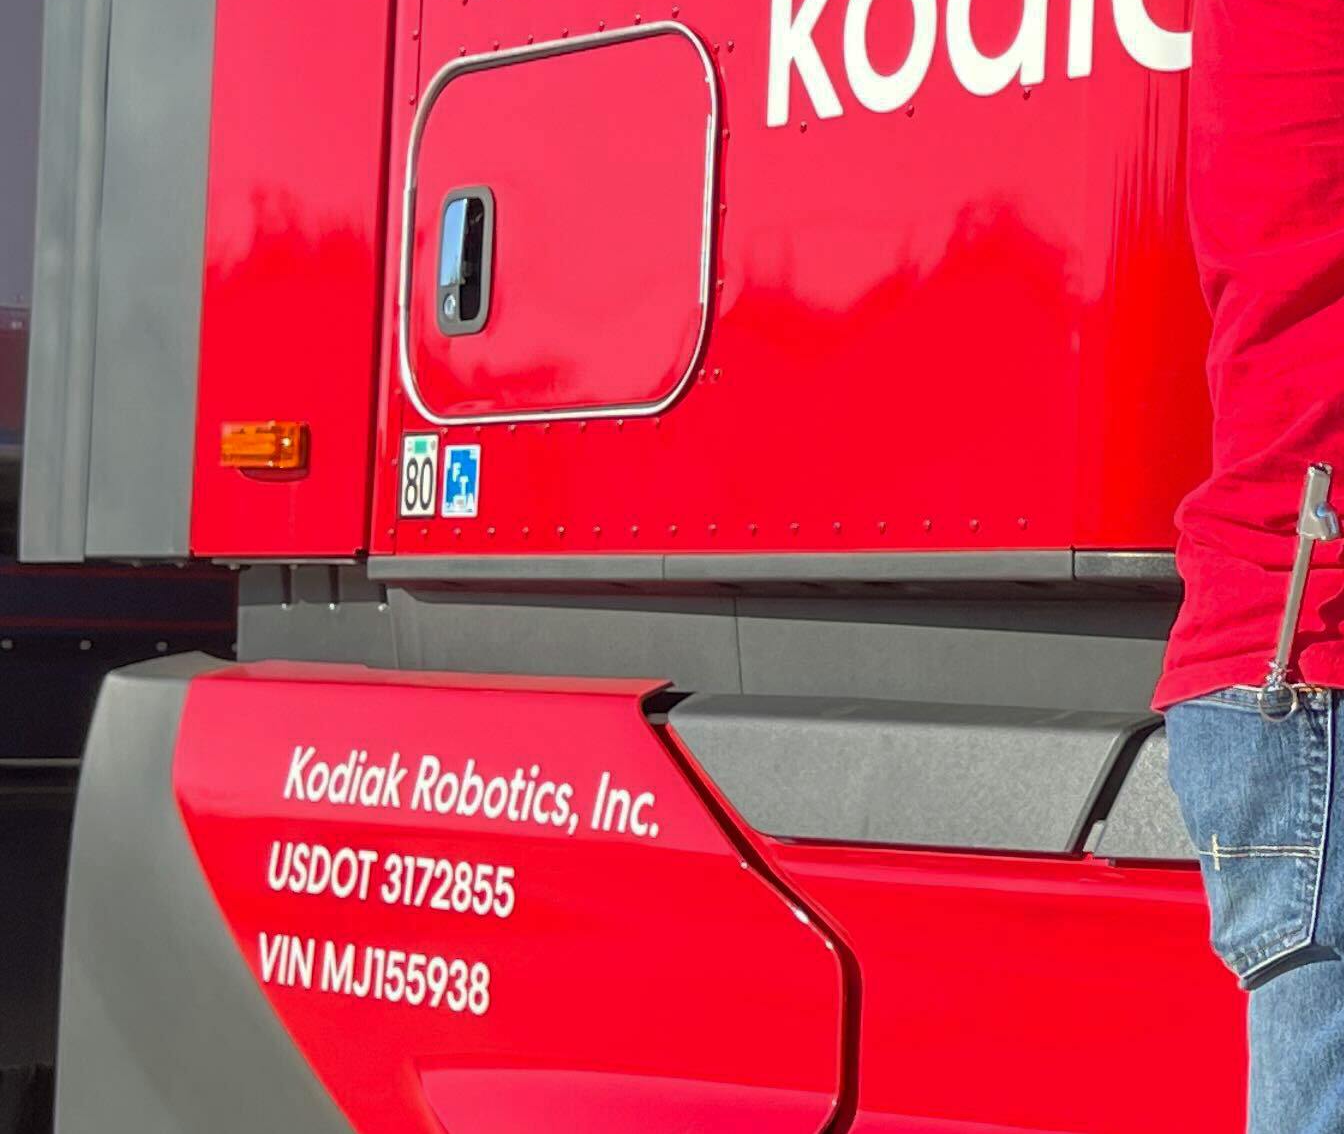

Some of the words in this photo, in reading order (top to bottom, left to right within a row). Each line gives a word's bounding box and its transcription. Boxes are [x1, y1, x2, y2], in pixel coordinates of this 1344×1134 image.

[404, 457, 433, 511] 80
[283, 745, 408, 808] Kodiak
[410, 754, 580, 836] Robotics,
[591, 771, 660, 838] Inc.
[267, 840, 378, 900] USDOT
[380, 852, 516, 919] 3172855
[258, 931, 315, 989] VIN
[320, 940, 491, 1016] MJ155938
